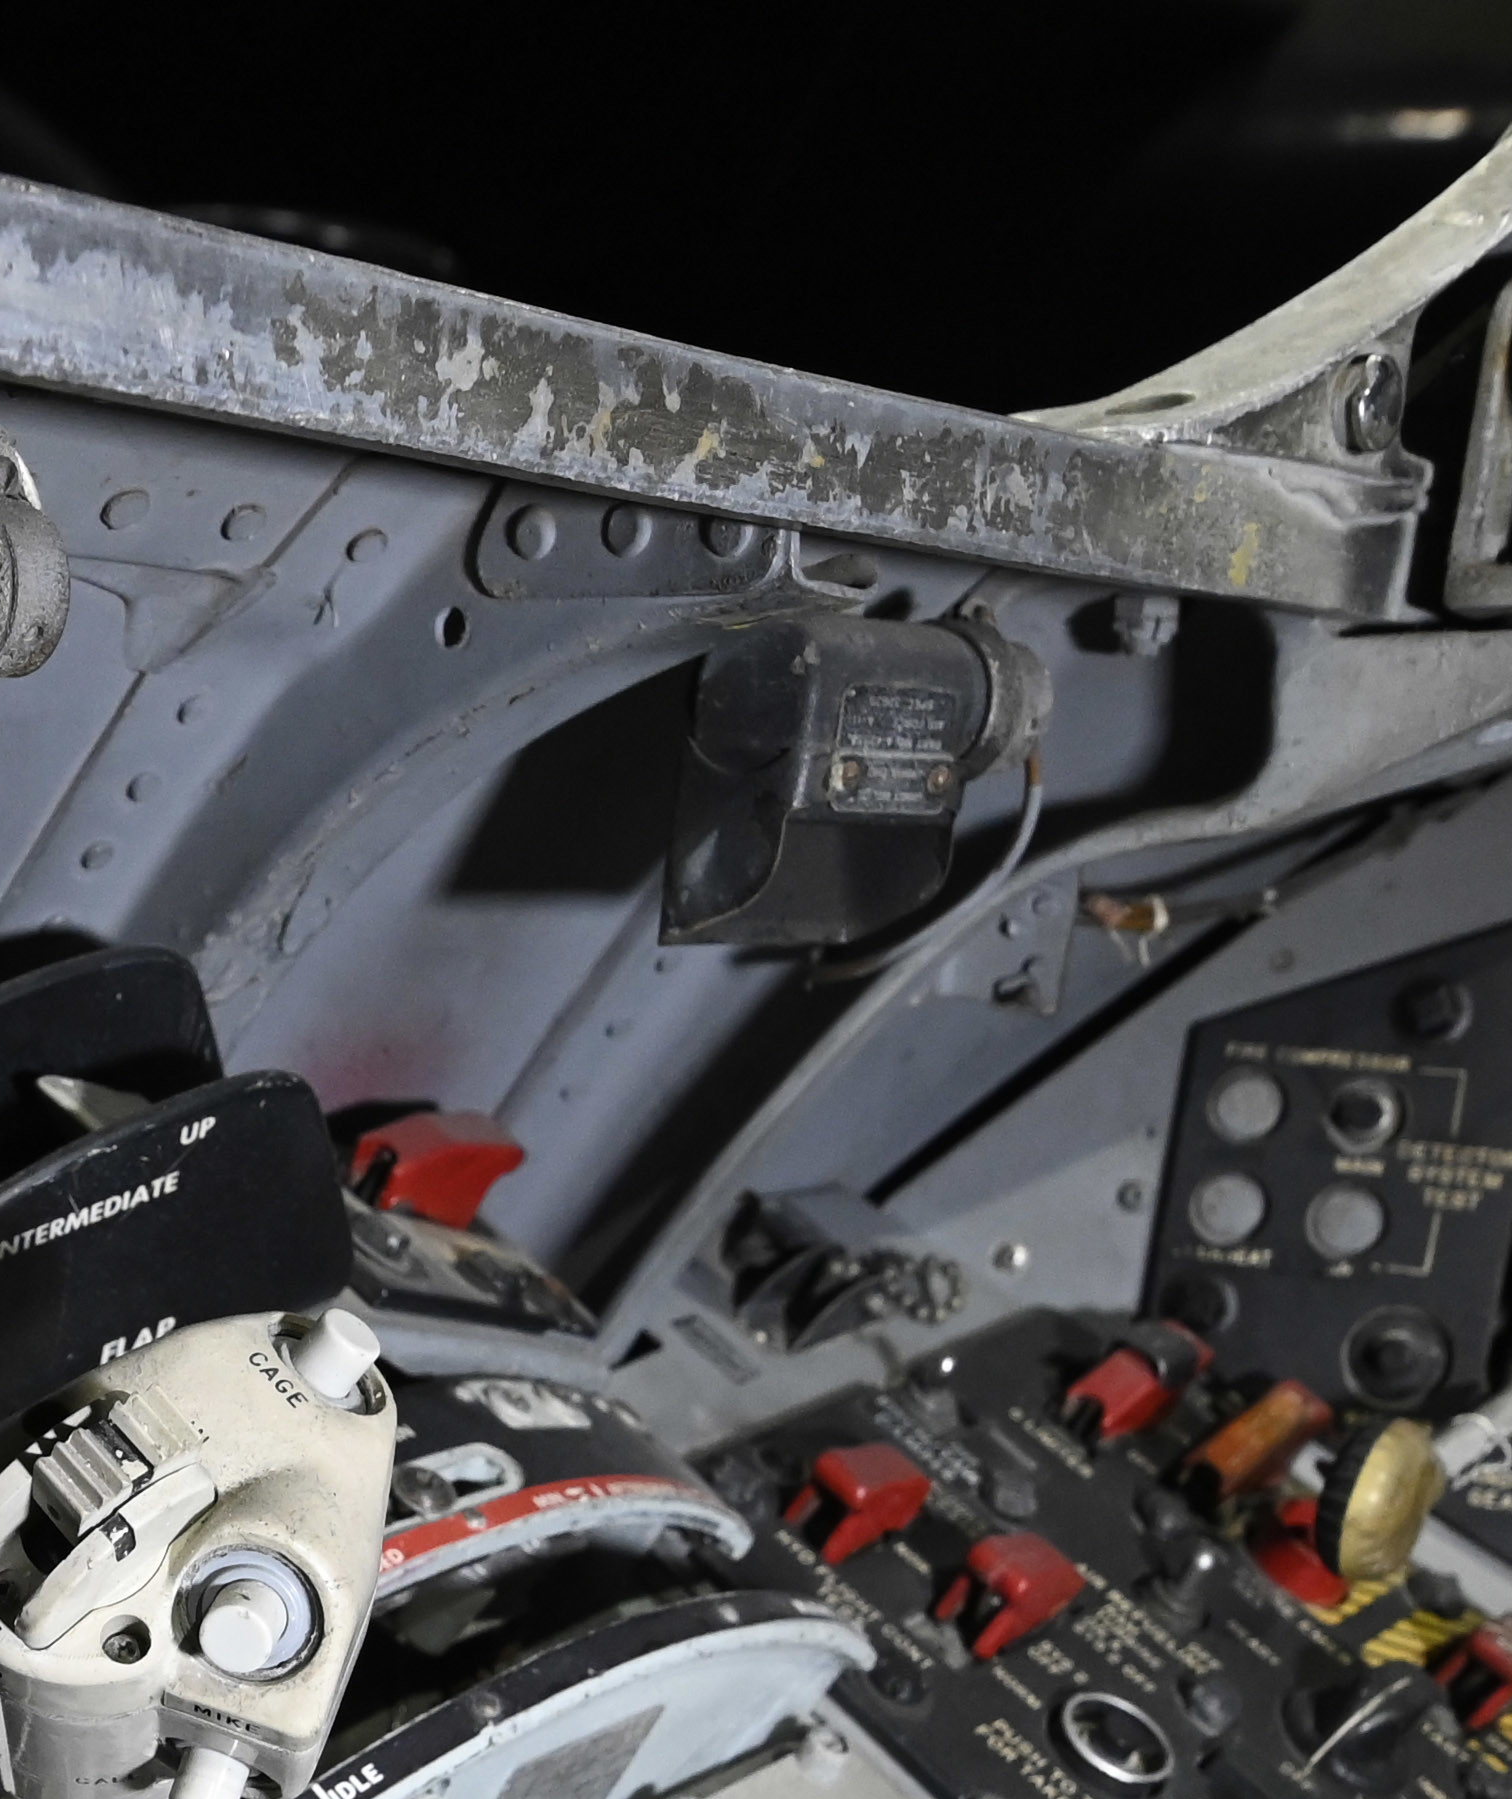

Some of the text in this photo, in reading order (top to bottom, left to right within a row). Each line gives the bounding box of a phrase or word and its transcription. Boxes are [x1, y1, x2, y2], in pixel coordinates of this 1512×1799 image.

[179, 1115, 217, 1147] UP
[99, 1315, 178, 1365] FLAP
[247, 1351, 306, 1412] CAGE
[192, 1703, 263, 1735] MIKE
